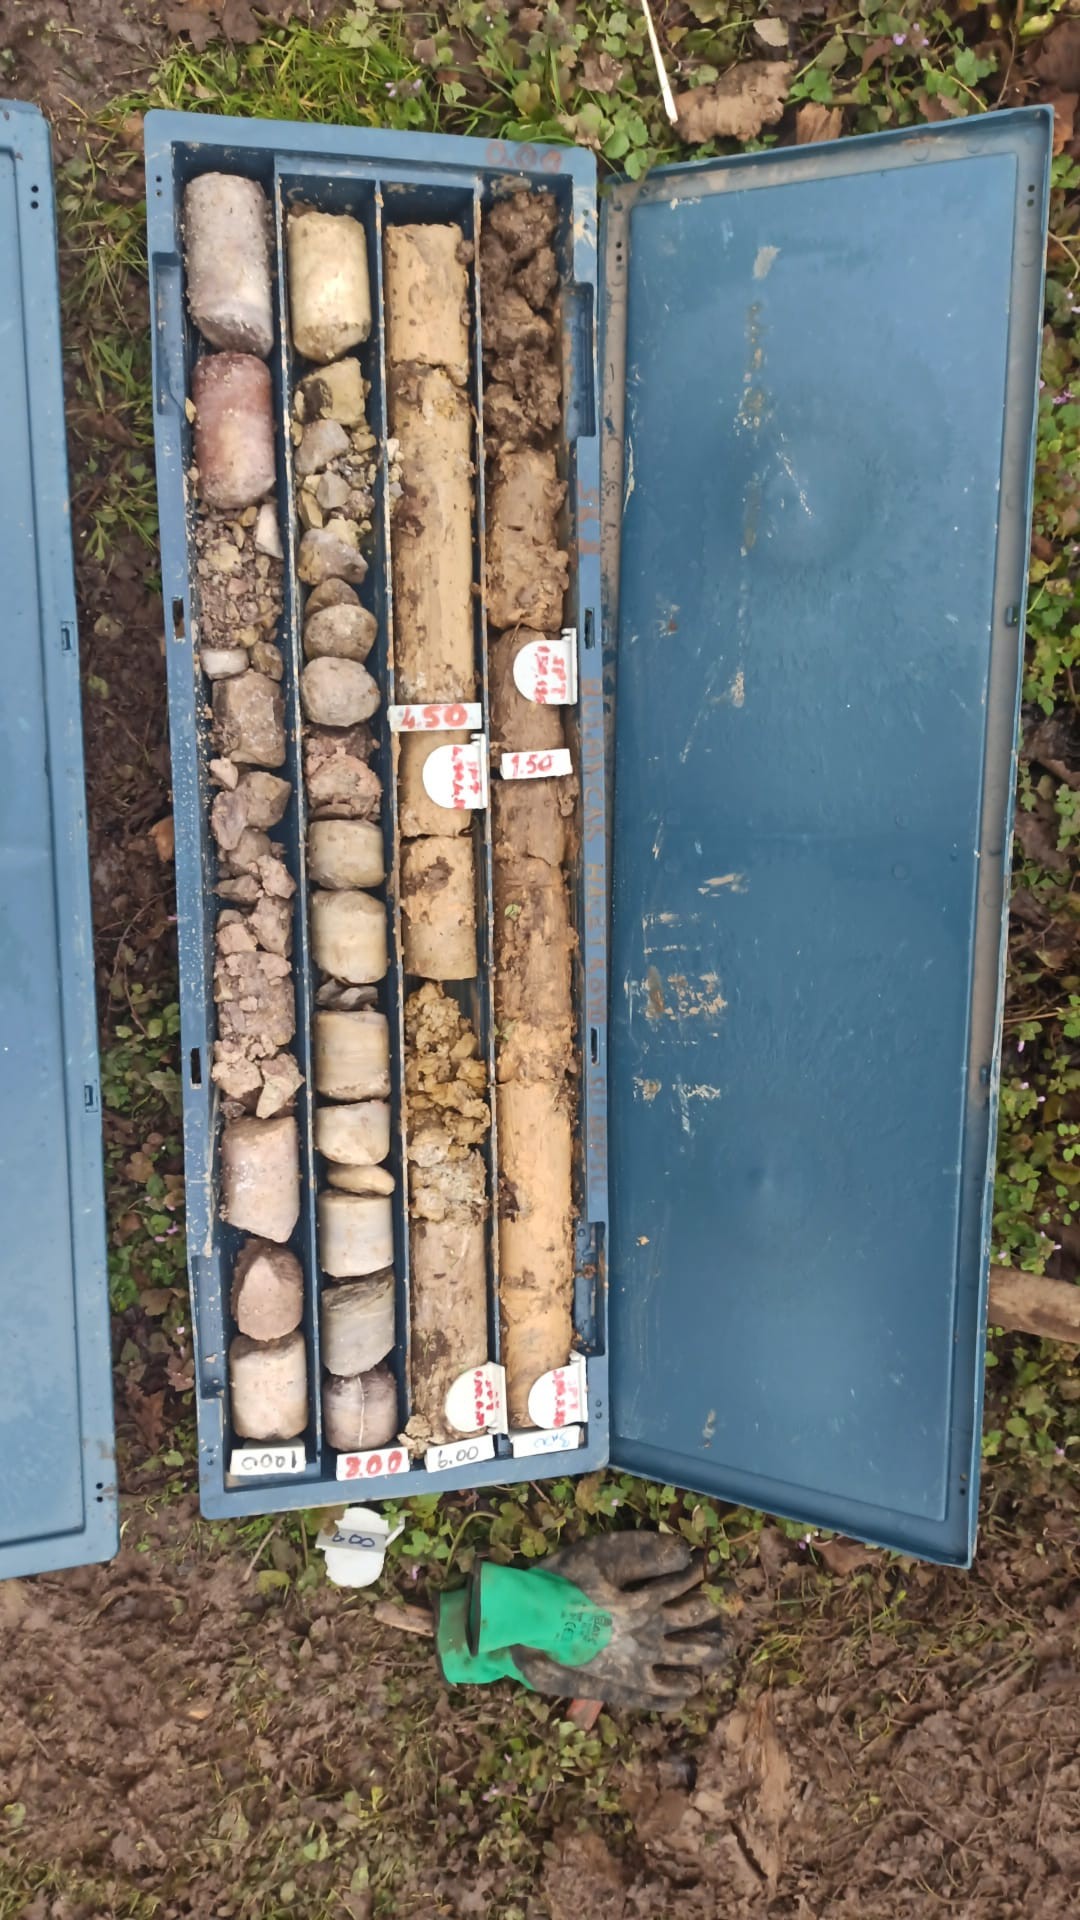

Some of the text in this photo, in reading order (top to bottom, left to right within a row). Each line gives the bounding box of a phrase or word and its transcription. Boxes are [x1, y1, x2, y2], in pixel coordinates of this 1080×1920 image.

[551, 656, 567, 699] SPT
[511, 754, 553, 777] 1.50
[438, 1446, 479, 1469] 6.00
